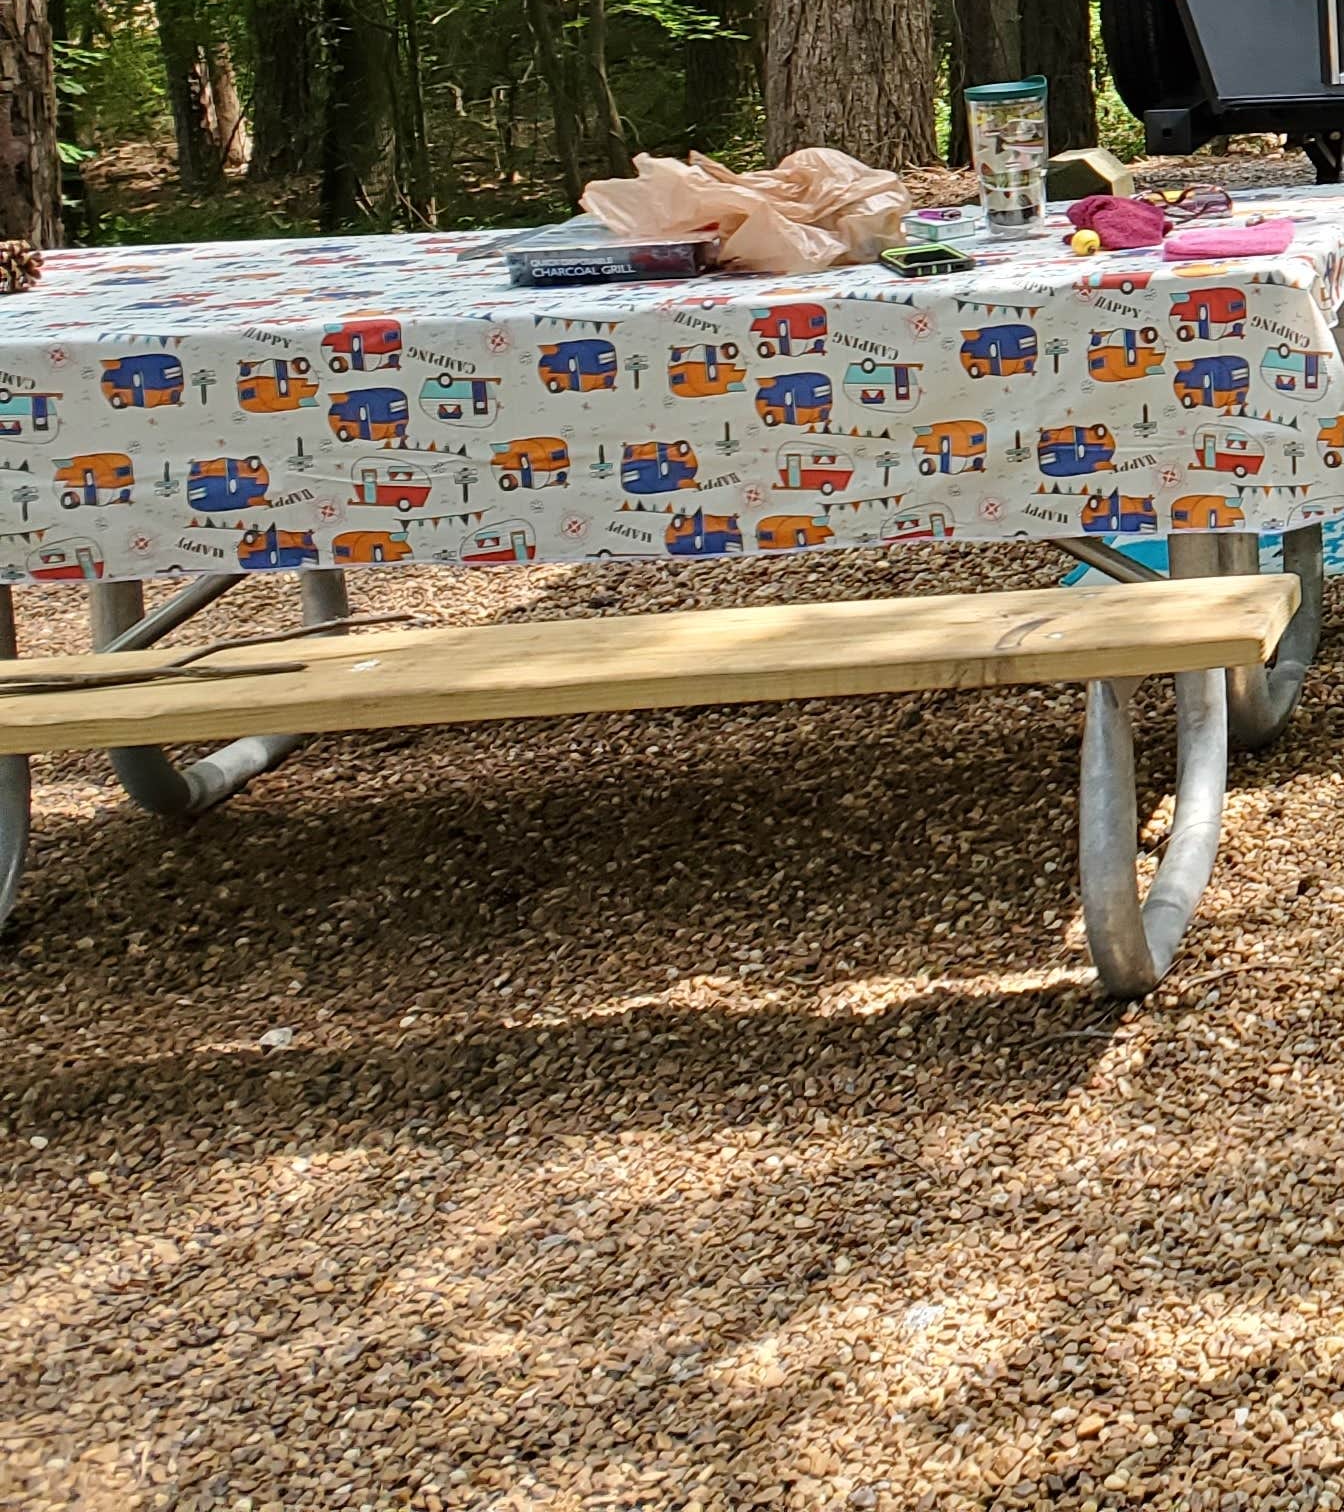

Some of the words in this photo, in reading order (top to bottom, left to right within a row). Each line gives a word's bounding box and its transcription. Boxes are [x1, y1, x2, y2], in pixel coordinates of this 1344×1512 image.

[531, 266, 601, 278] CHARCOAL
[601, 263, 637, 275] GRILL
[1094, 296, 1142, 319] HAPPY
[673, 311, 721, 335] HAPPY
[242, 327, 293, 349] HAPPY
